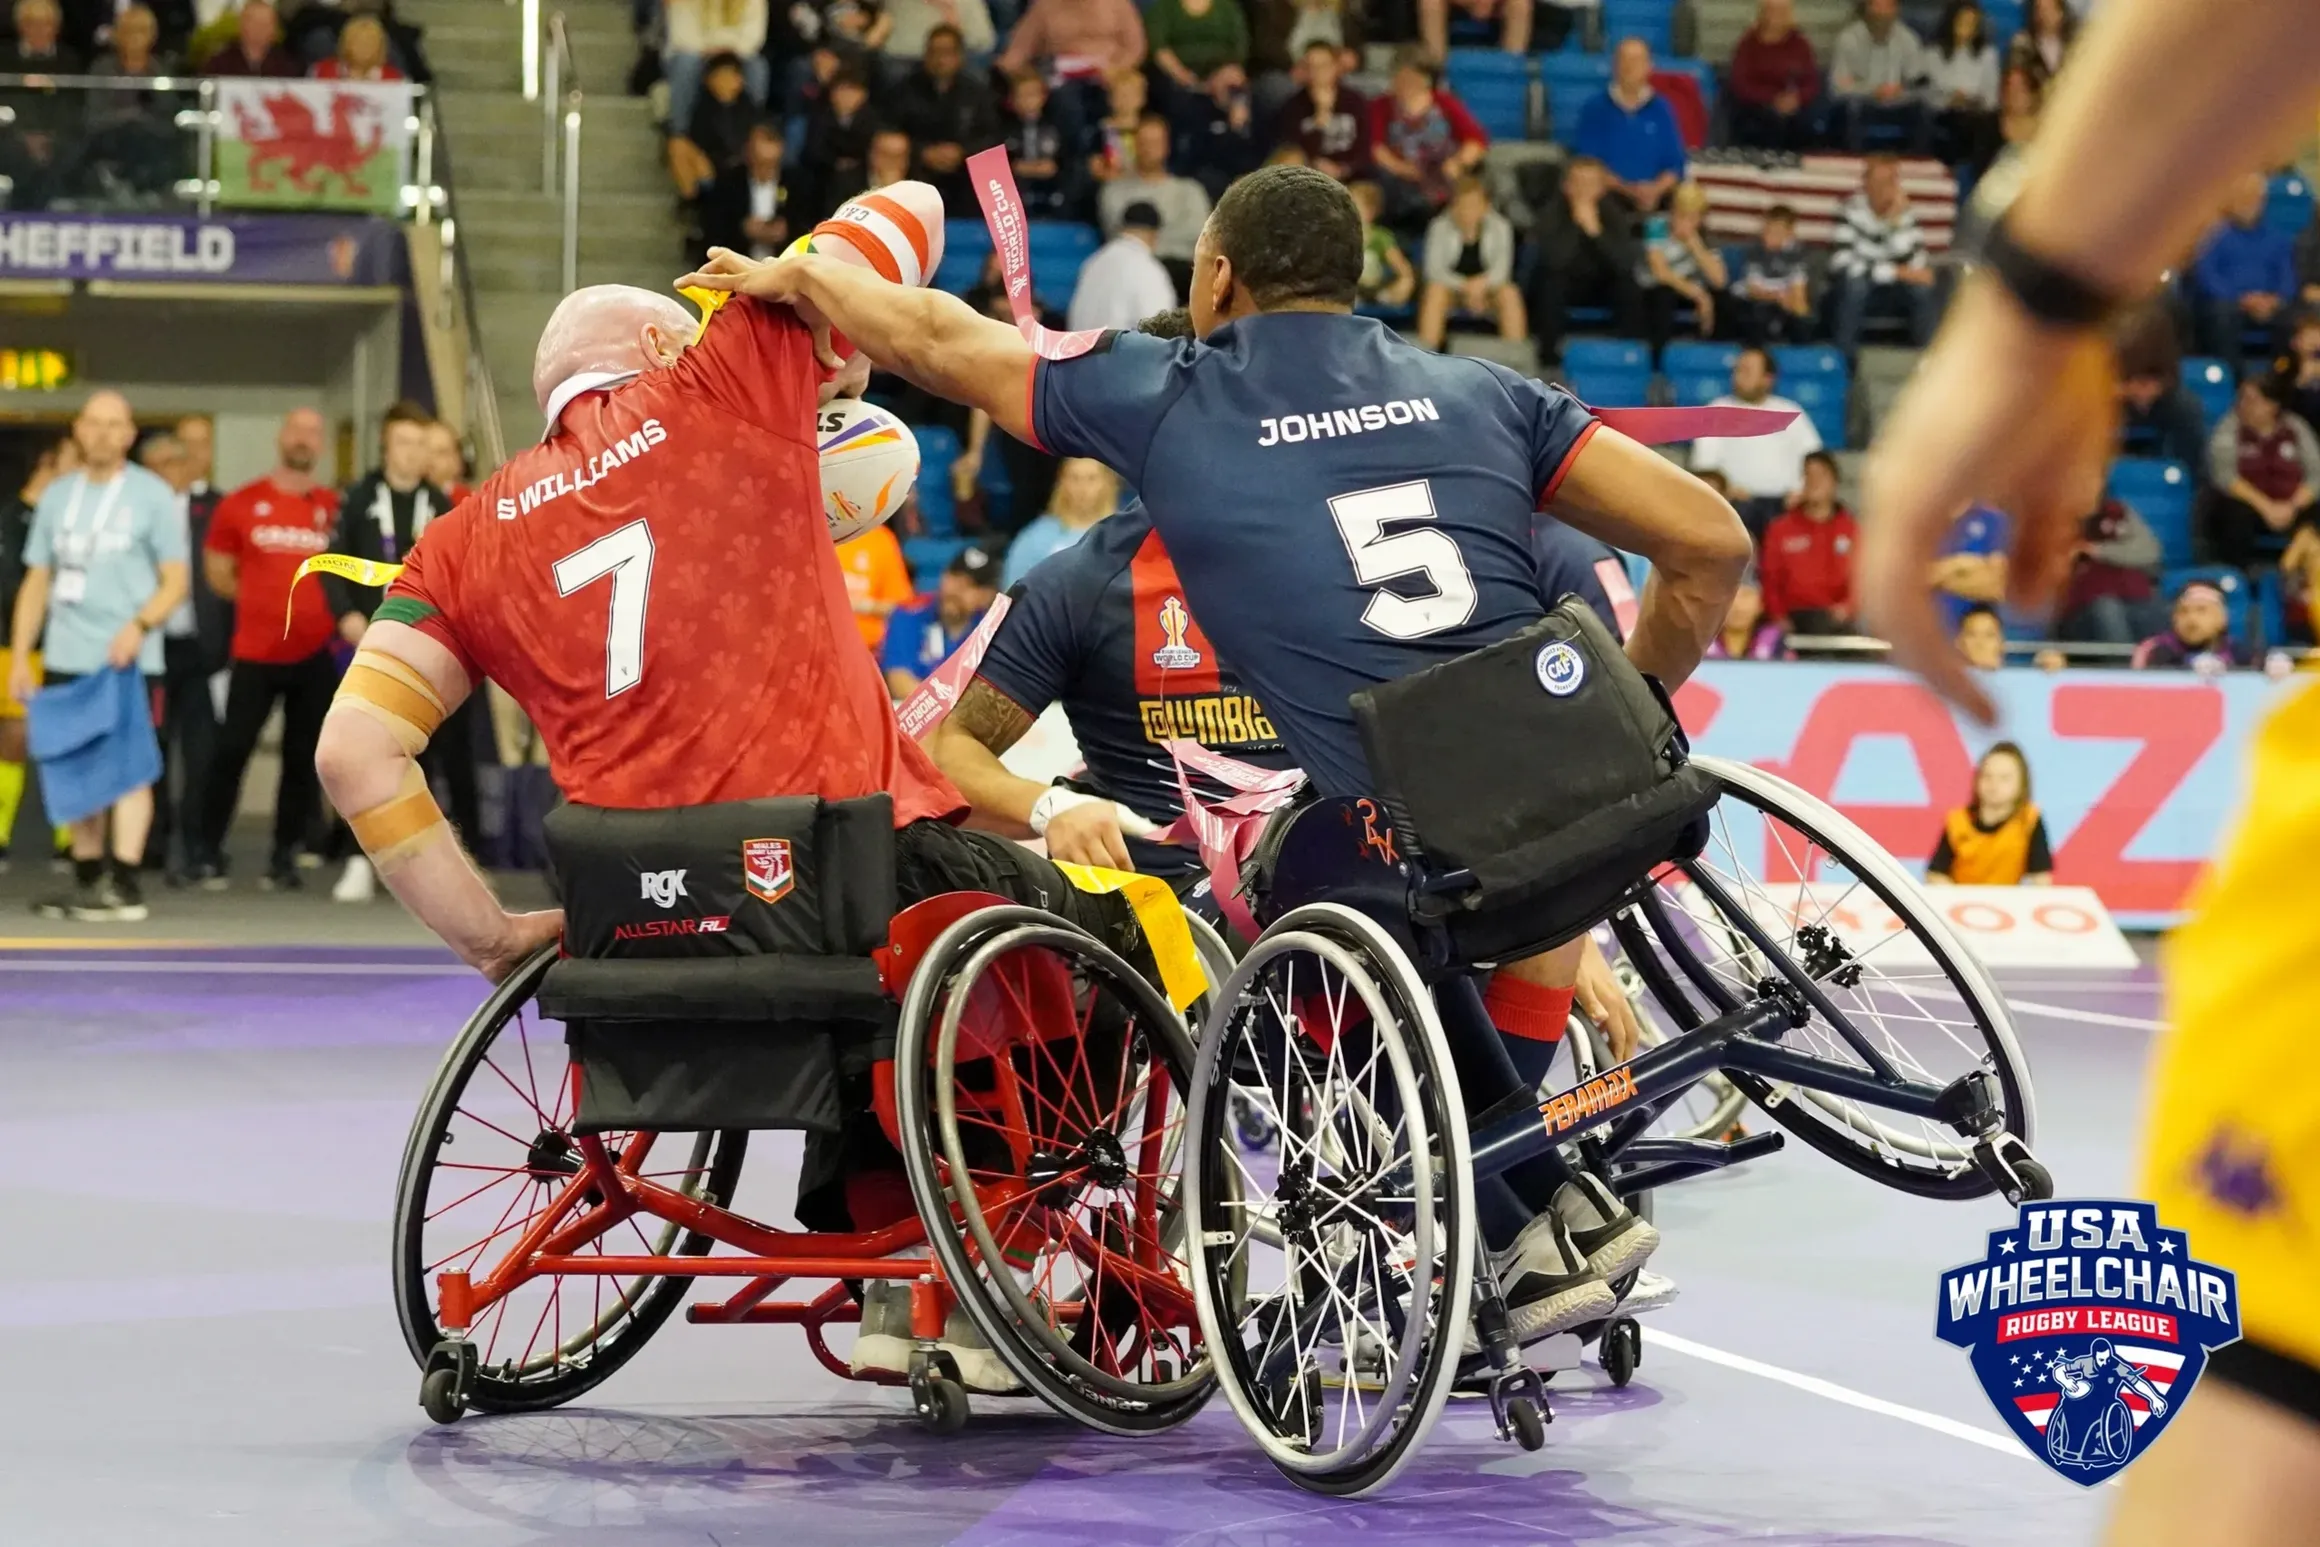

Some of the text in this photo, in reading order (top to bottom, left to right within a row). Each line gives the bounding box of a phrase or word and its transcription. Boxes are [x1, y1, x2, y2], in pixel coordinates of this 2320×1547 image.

[989, 179, 1020, 274] WORLD CUP
[497, 418, 667, 520] S WILLIAMS
[1258, 398, 1440, 446] JOHNSON
[1326, 479, 1478, 639] 5
[551, 517, 656, 700] 7
[905, 695, 938, 728] WORLD
[614, 919, 728, 941] ALLSTAR RL
